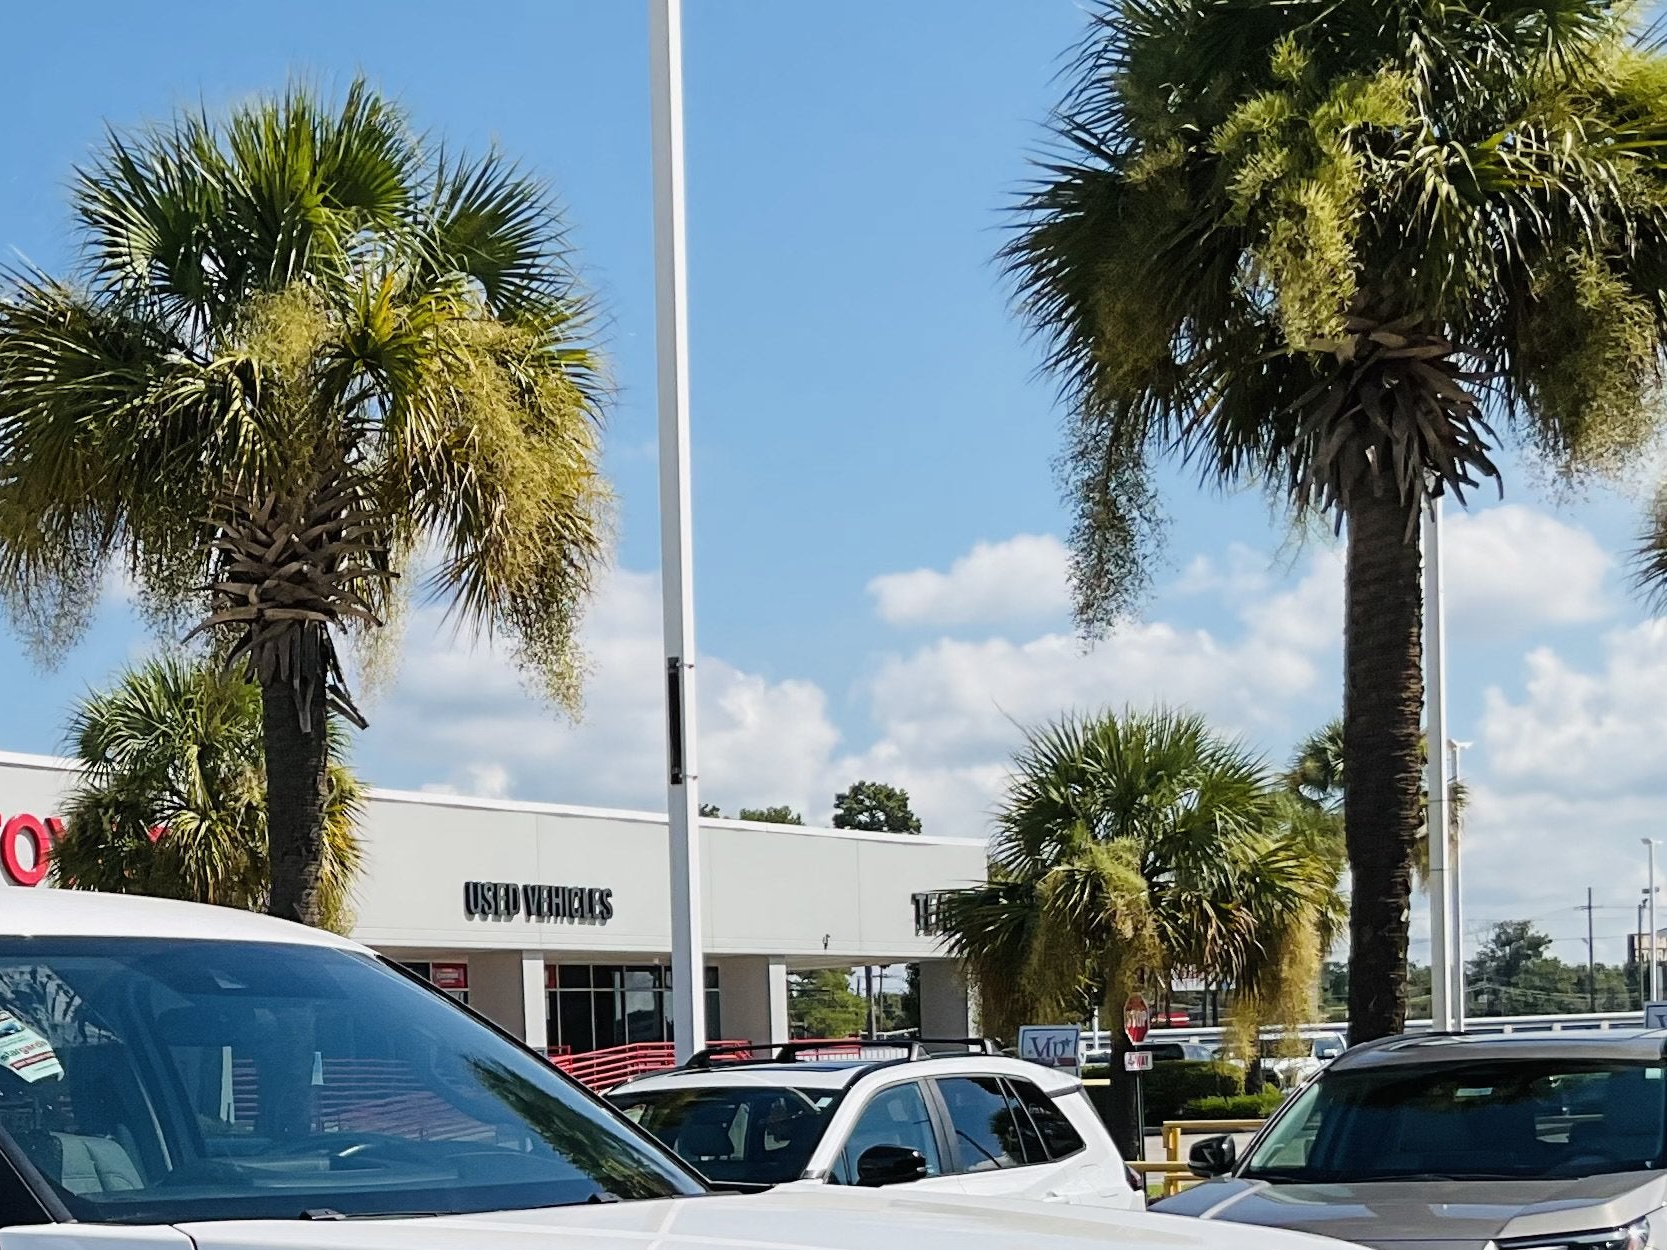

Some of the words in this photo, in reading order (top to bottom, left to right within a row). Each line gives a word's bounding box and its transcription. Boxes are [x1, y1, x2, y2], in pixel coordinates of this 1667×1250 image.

[464, 882, 520, 916] USED
[521, 884, 613, 920] VEHICLES
[1126, 1010, 1147, 1028] STOP
